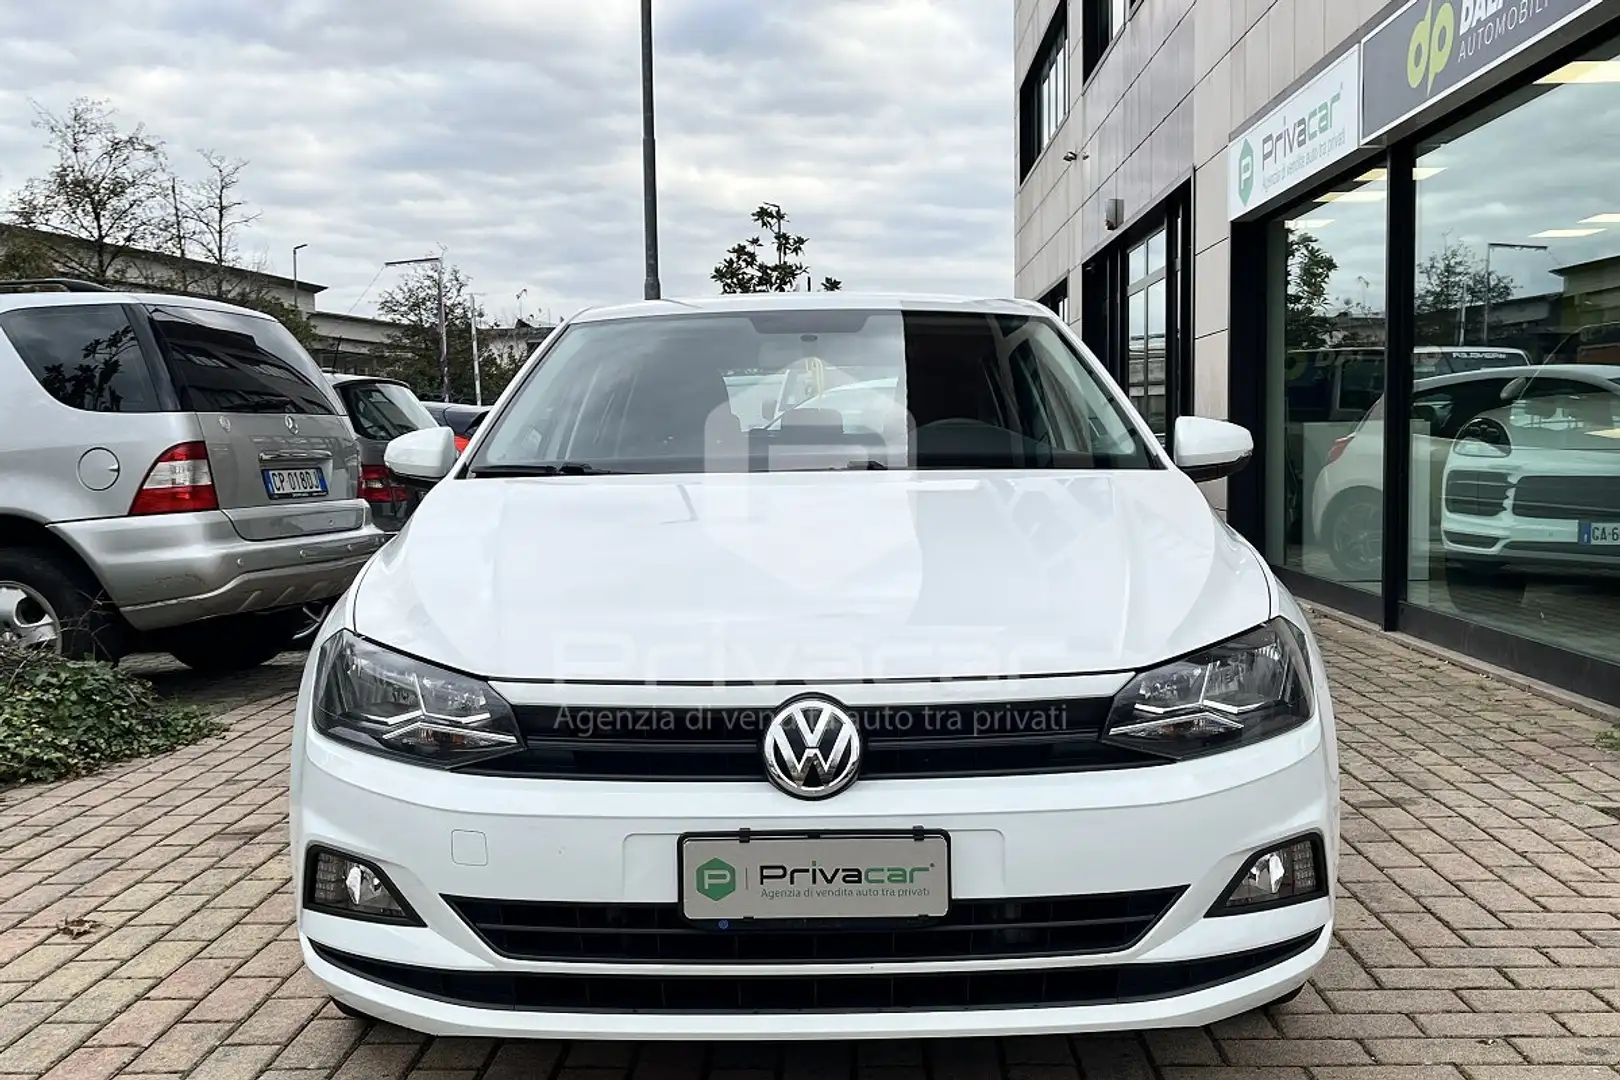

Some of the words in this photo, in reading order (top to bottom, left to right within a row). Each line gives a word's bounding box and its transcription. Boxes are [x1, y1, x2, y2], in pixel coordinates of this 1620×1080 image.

[1460, 0, 1504, 36] DAL
[1262, 92, 1341, 171] Privacar
[271, 472, 285, 491] CP
[760, 860, 930, 885] Privacar
[760, 888, 801, 900] Agenzia
[804, 888, 813, 897] di
[816, 888, 852, 898] vendita
[856, 887, 878, 897] auto
[881, 887, 894, 897] tra
[898, 886, 930, 898] privati
